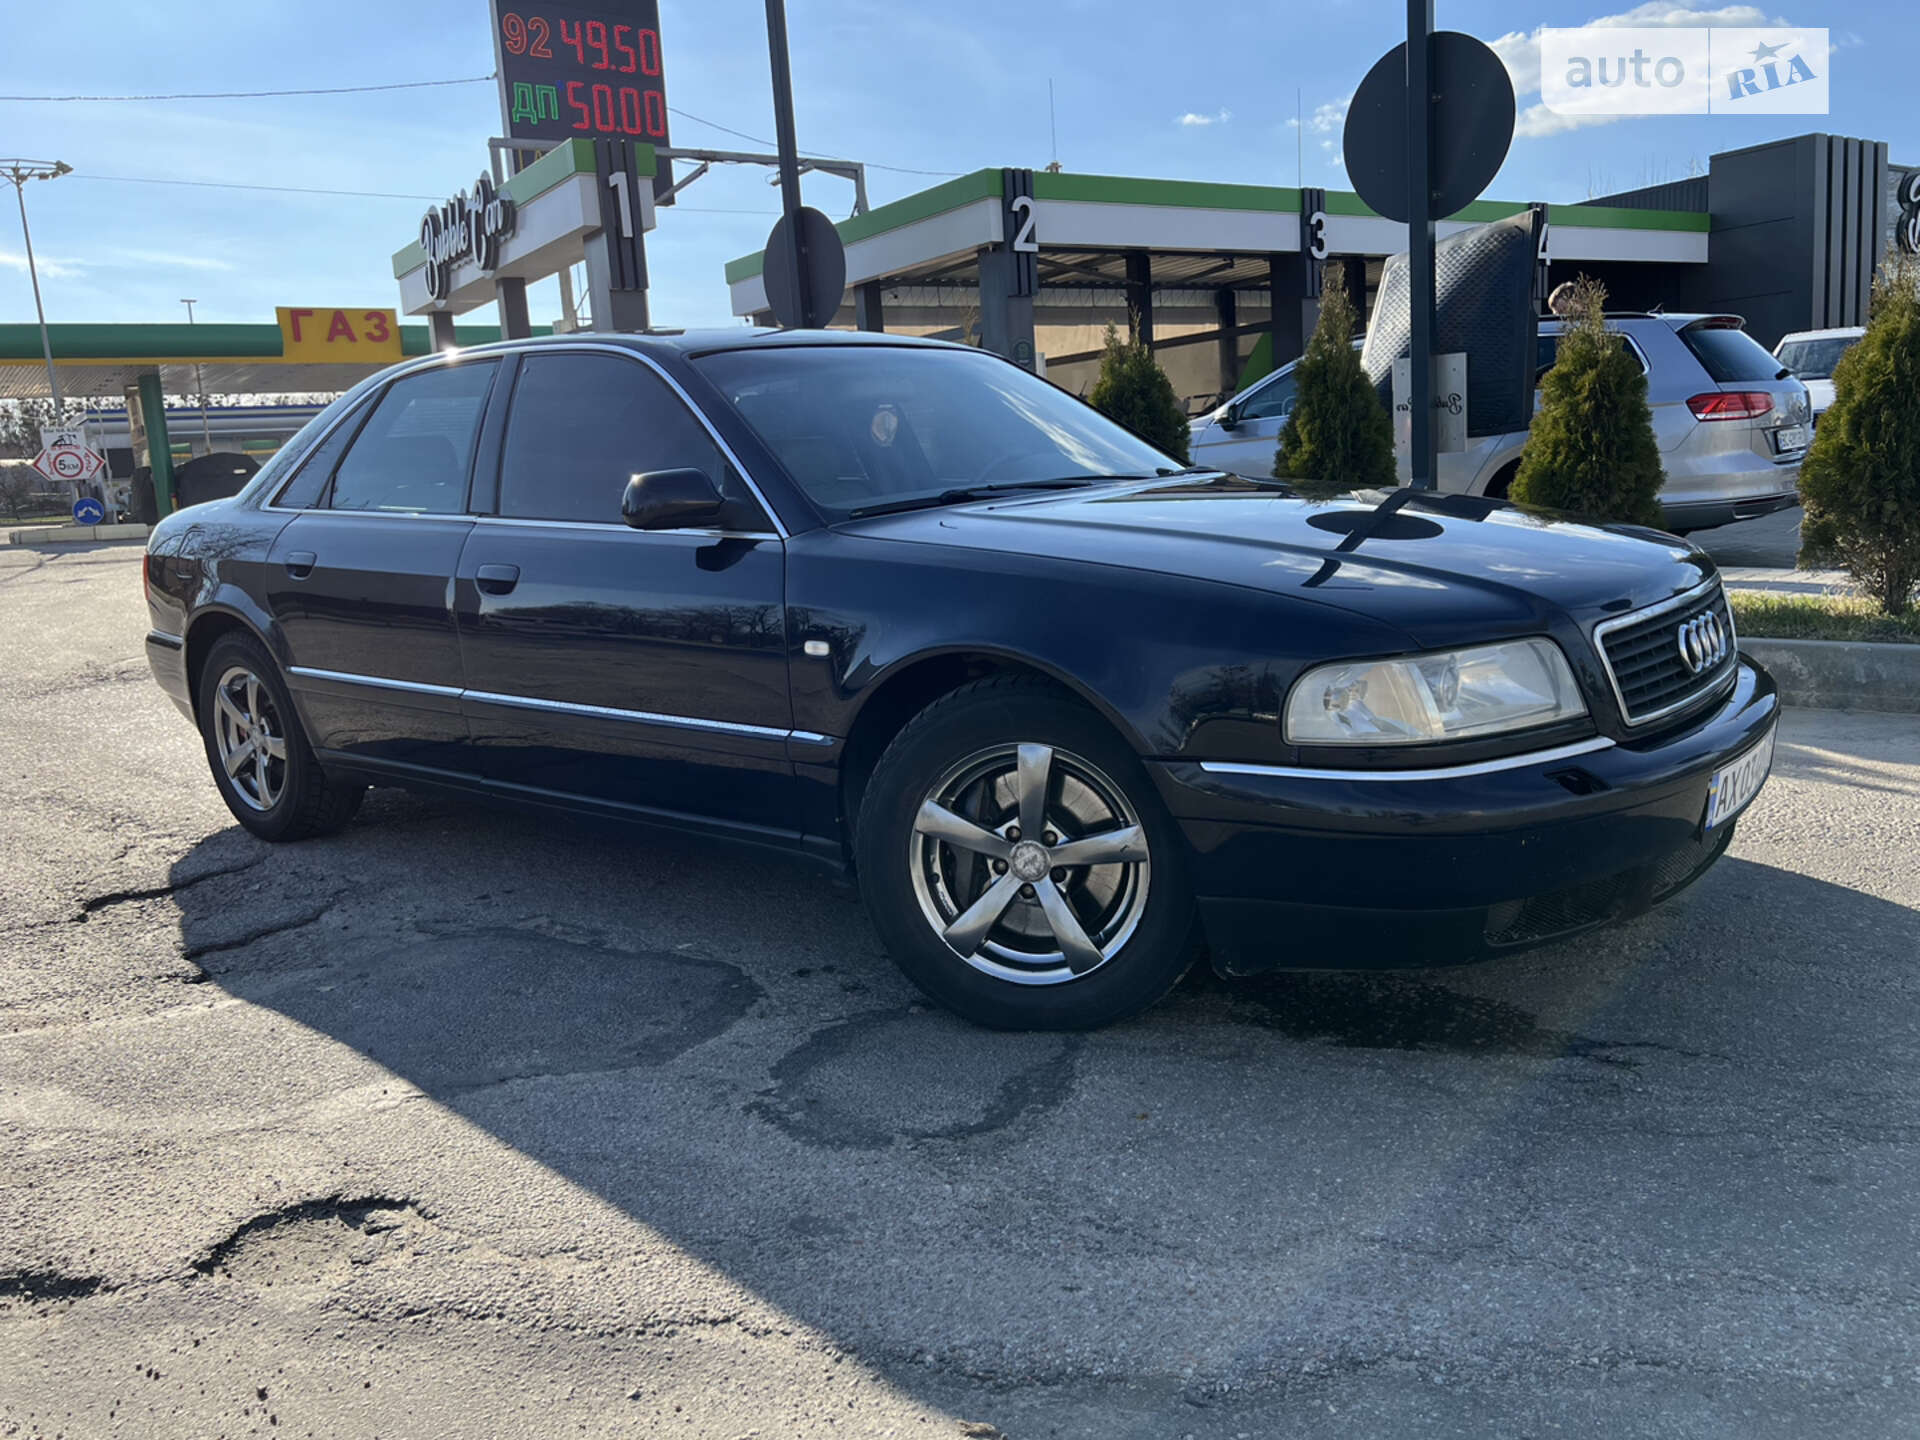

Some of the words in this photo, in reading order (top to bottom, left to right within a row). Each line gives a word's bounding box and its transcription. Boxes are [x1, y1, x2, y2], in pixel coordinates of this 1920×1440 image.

[502, 12, 552, 58] 92
[559, 19, 660, 76] 49.50
[566, 81, 666, 137] 50.00
[608, 171, 633, 238] 1
[1011, 195, 1039, 252] 2
[420, 196, 469, 299] Bubble
[1309, 211, 1328, 260] 3
[1537, 222, 1552, 266] 4
[289, 309, 390, 342] ГАЗ
